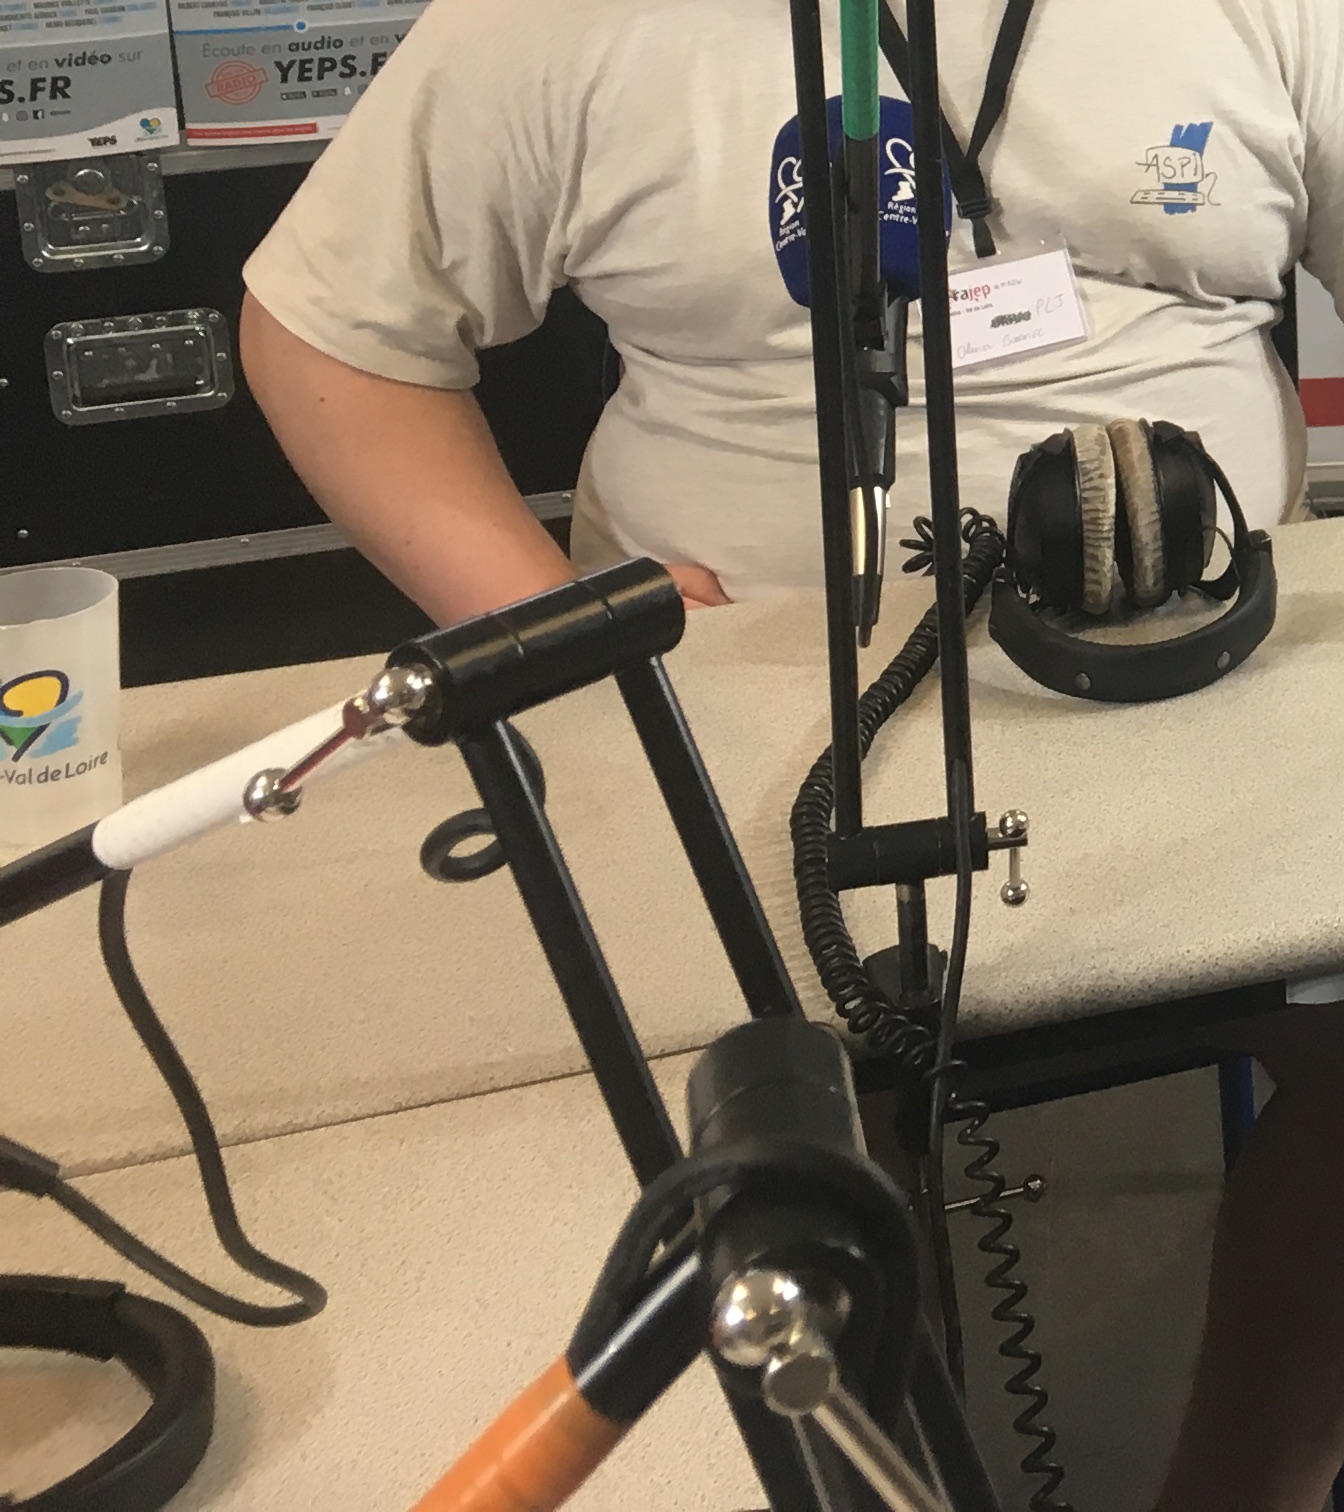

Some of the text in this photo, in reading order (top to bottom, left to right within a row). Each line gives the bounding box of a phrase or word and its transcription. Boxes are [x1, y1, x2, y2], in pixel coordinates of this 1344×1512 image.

[261, 45, 281, 55] en
[288, 35, 343, 53] audio
[28, 58, 49, 71] en
[54, 50, 112, 68] vidéo
[118, 49, 143, 63] sur
[273, 51, 389, 84] YEPS.F
[36, 764, 61, 785] de
[64, 750, 109, 780] Loire
